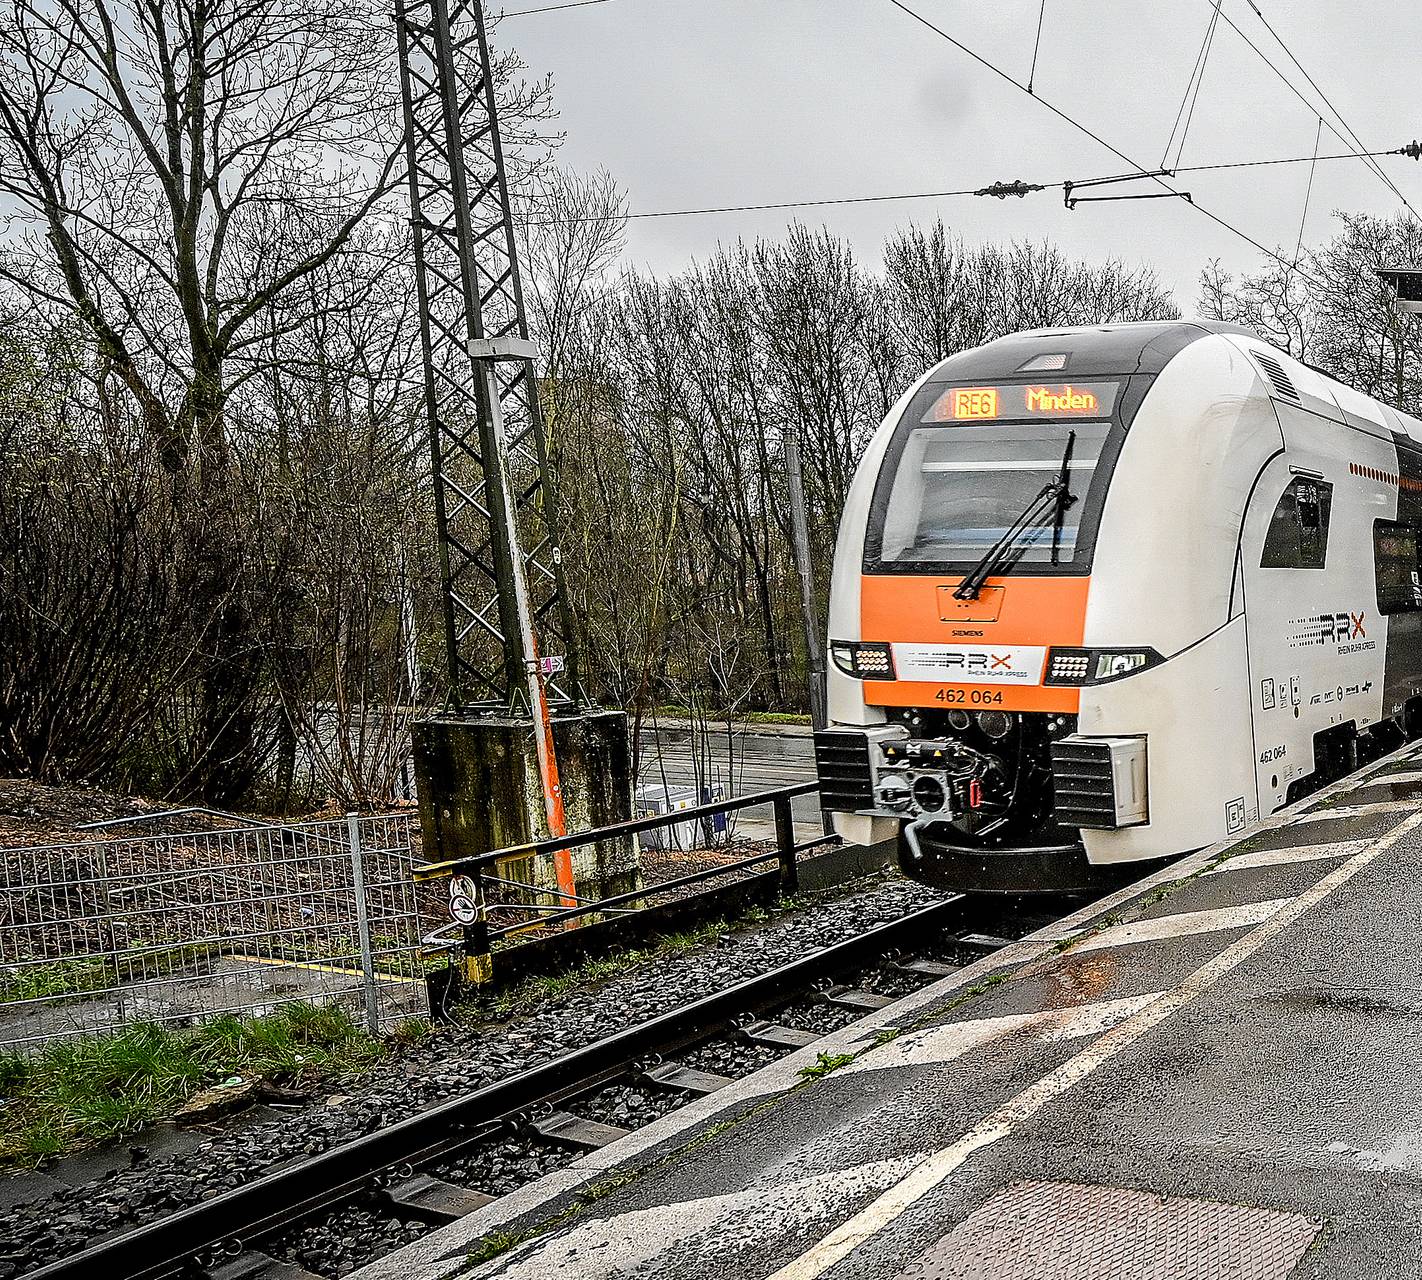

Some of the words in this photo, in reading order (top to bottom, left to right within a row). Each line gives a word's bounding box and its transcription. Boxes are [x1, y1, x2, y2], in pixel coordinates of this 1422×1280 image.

[958, 393, 992, 416] RE6
[1027, 386, 1095, 411] Minden
[951, 629, 984, 637] SIEMENS
[1315, 610, 1367, 646] RRX
[942, 652, 1012, 669] RRX
[935, 689, 966, 703] 462
[970, 690, 1004, 705] 064
[1259, 749, 1273, 765] 462
[1274, 744, 1287, 760] 064
